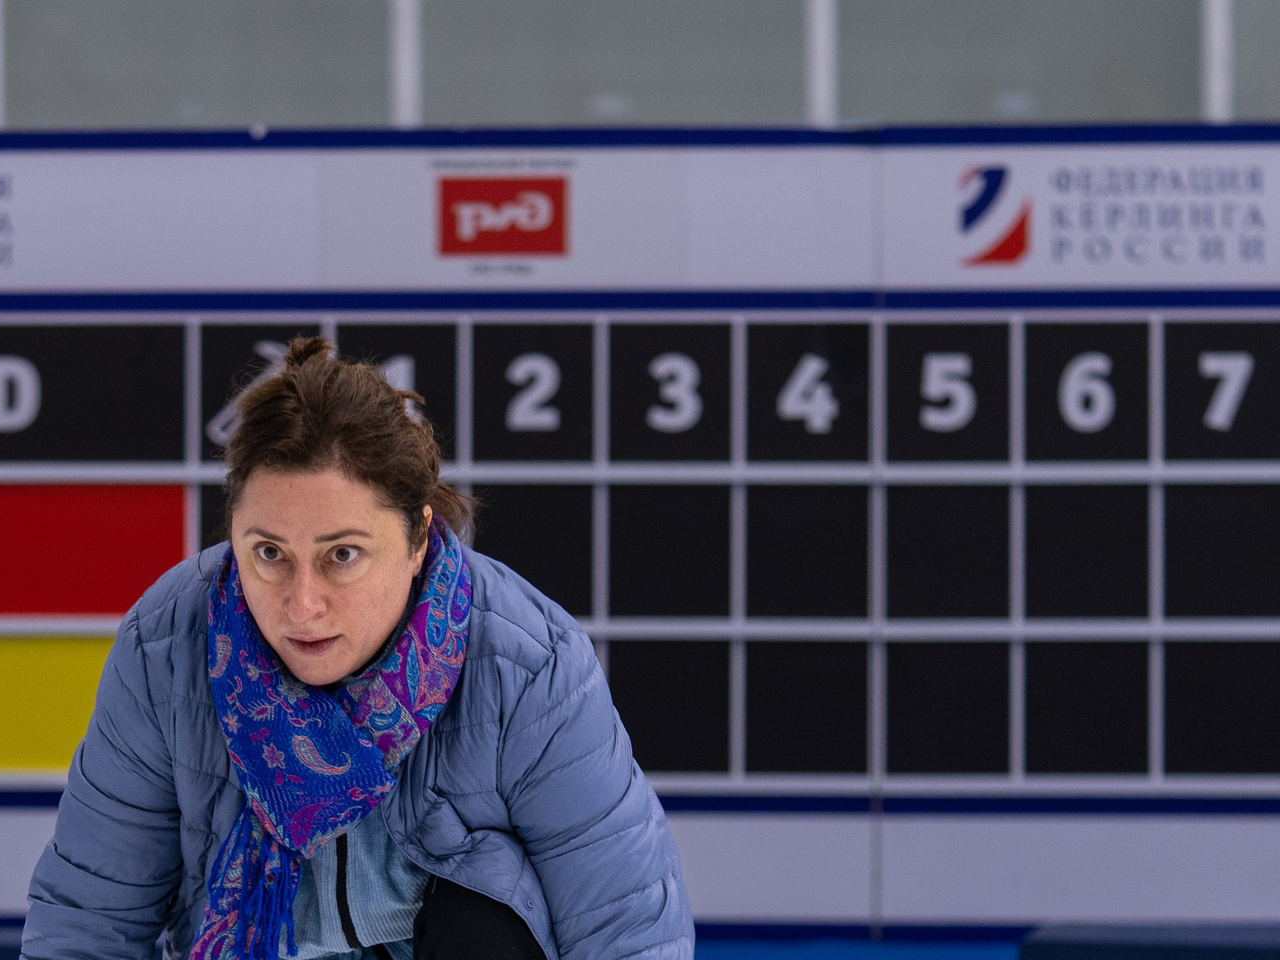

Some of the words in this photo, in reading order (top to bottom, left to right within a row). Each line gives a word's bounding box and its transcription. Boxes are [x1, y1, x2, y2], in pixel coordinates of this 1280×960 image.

[506, 353, 561, 431] 2
[647, 353, 703, 433] 3
[776, 353, 839, 433] 4
[920, 353, 977, 432] 5
[1058, 352, 1116, 433] 6
[1199, 352, 1255, 431] 7
